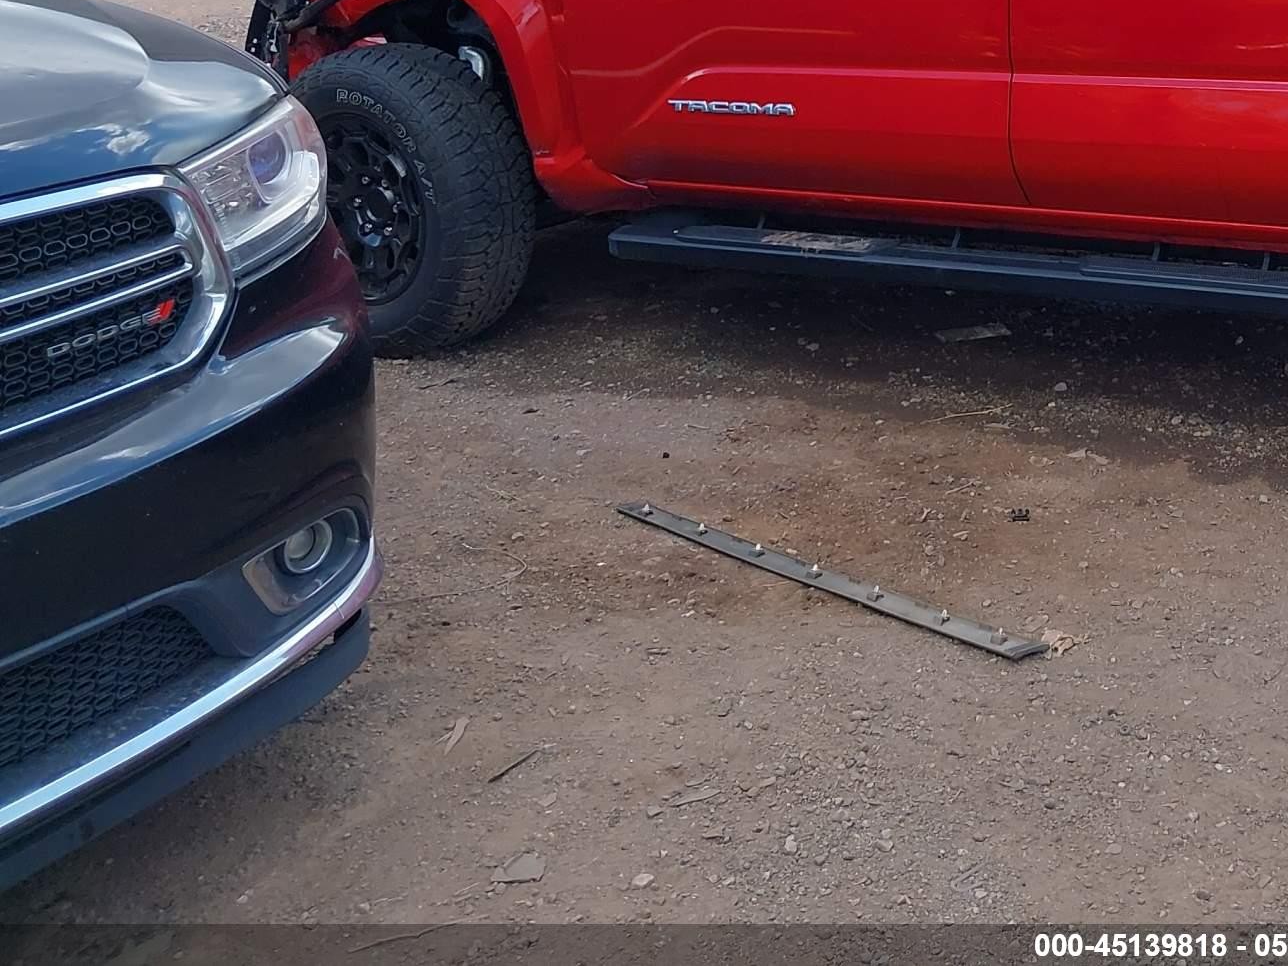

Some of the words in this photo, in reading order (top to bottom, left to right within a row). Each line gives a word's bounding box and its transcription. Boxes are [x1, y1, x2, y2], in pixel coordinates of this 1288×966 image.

[667, 99, 796, 117] TACOMA
[336, 88, 417, 154] ROTATOR
[413, 159, 436, 205] A/T
[47, 306, 163, 357] DODGE
